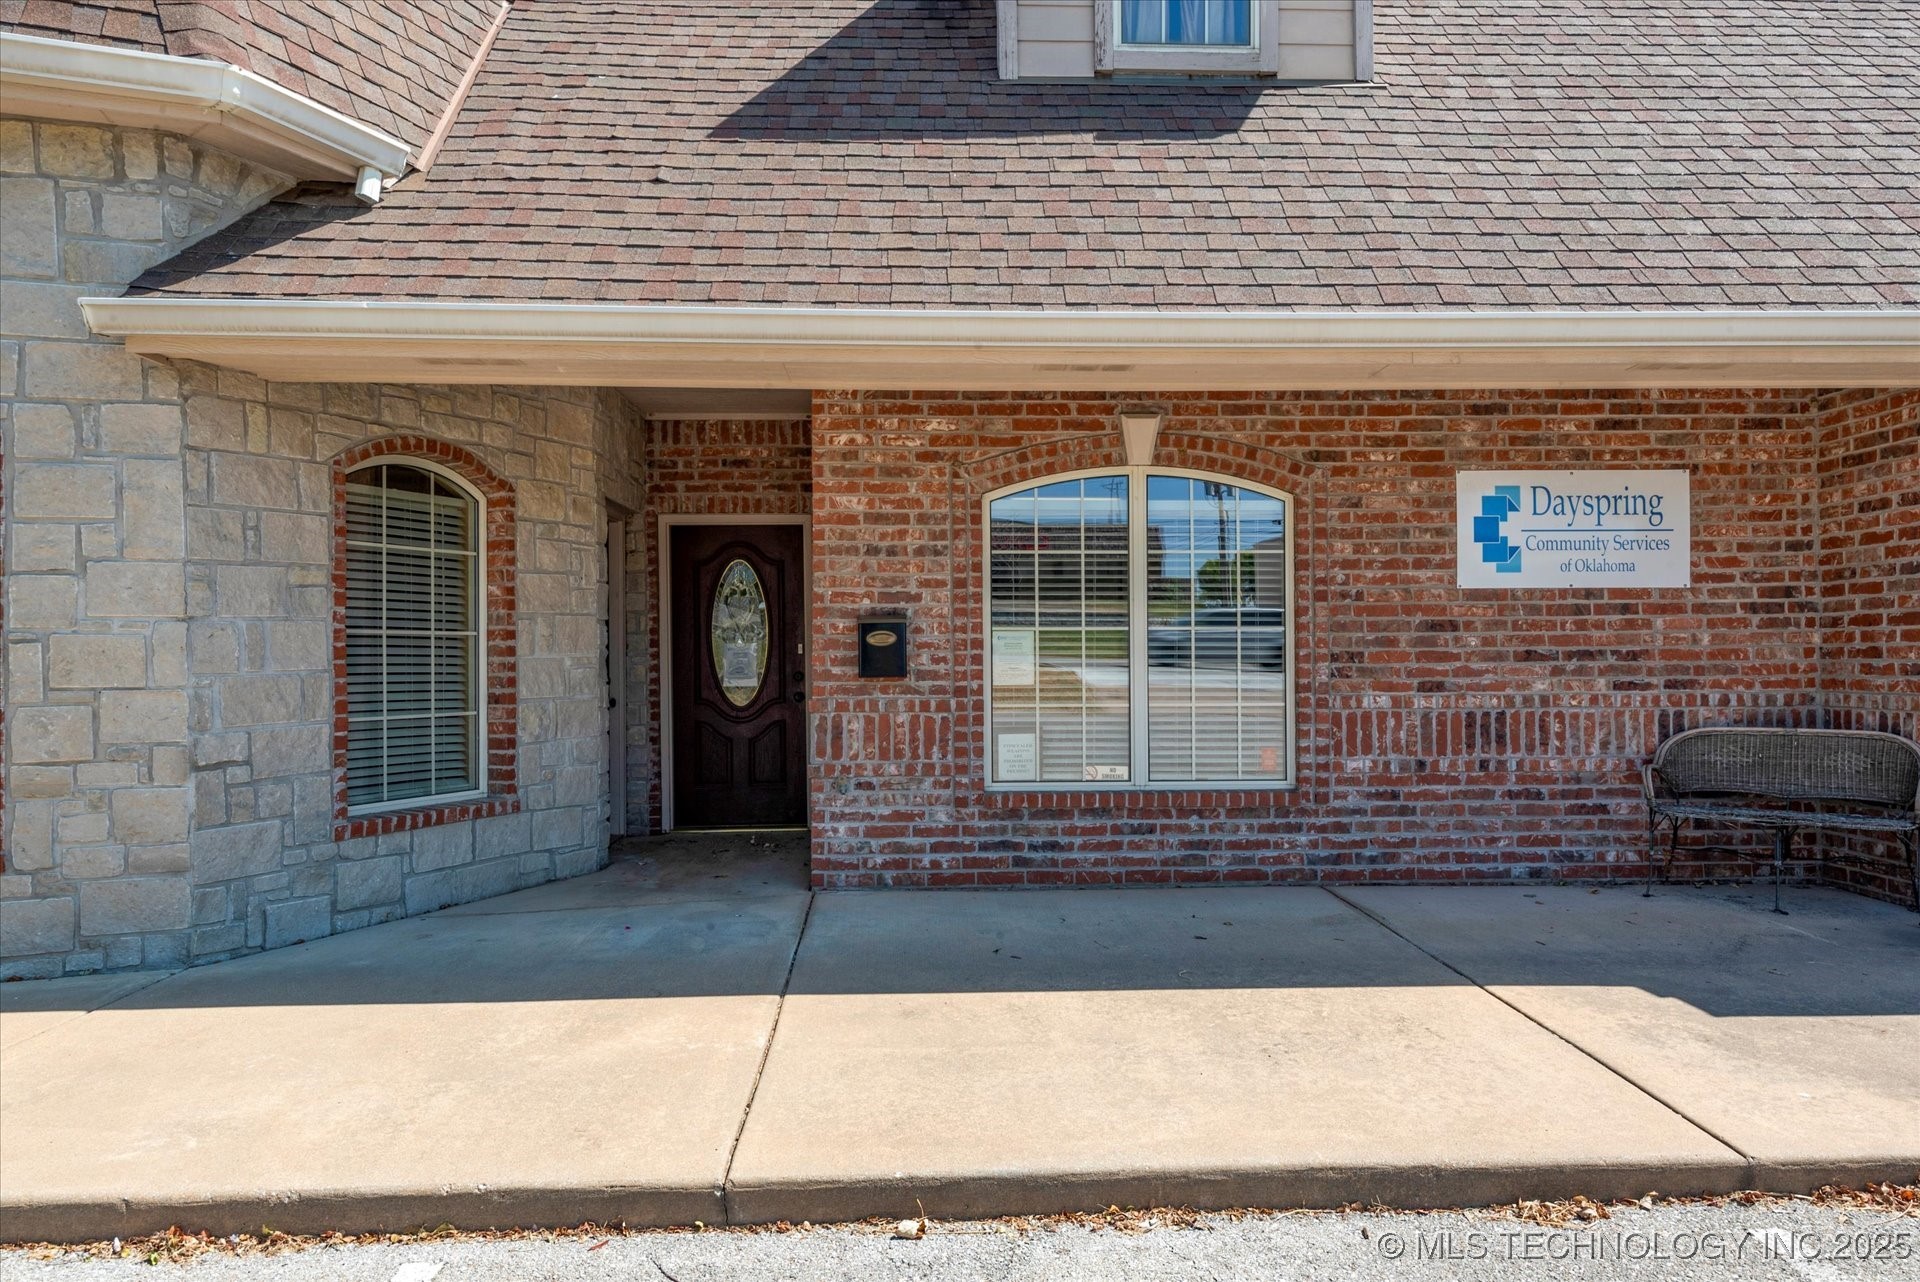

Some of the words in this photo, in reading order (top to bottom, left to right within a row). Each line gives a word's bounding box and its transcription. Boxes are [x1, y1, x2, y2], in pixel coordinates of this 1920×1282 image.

[1530, 485, 1664, 527] Dayspring
[1525, 535, 1609, 556] Community
[1613, 535, 1670, 551] Services
[1560, 559, 1574, 573] of
[1574, 559, 1636, 573] Oklahoma
